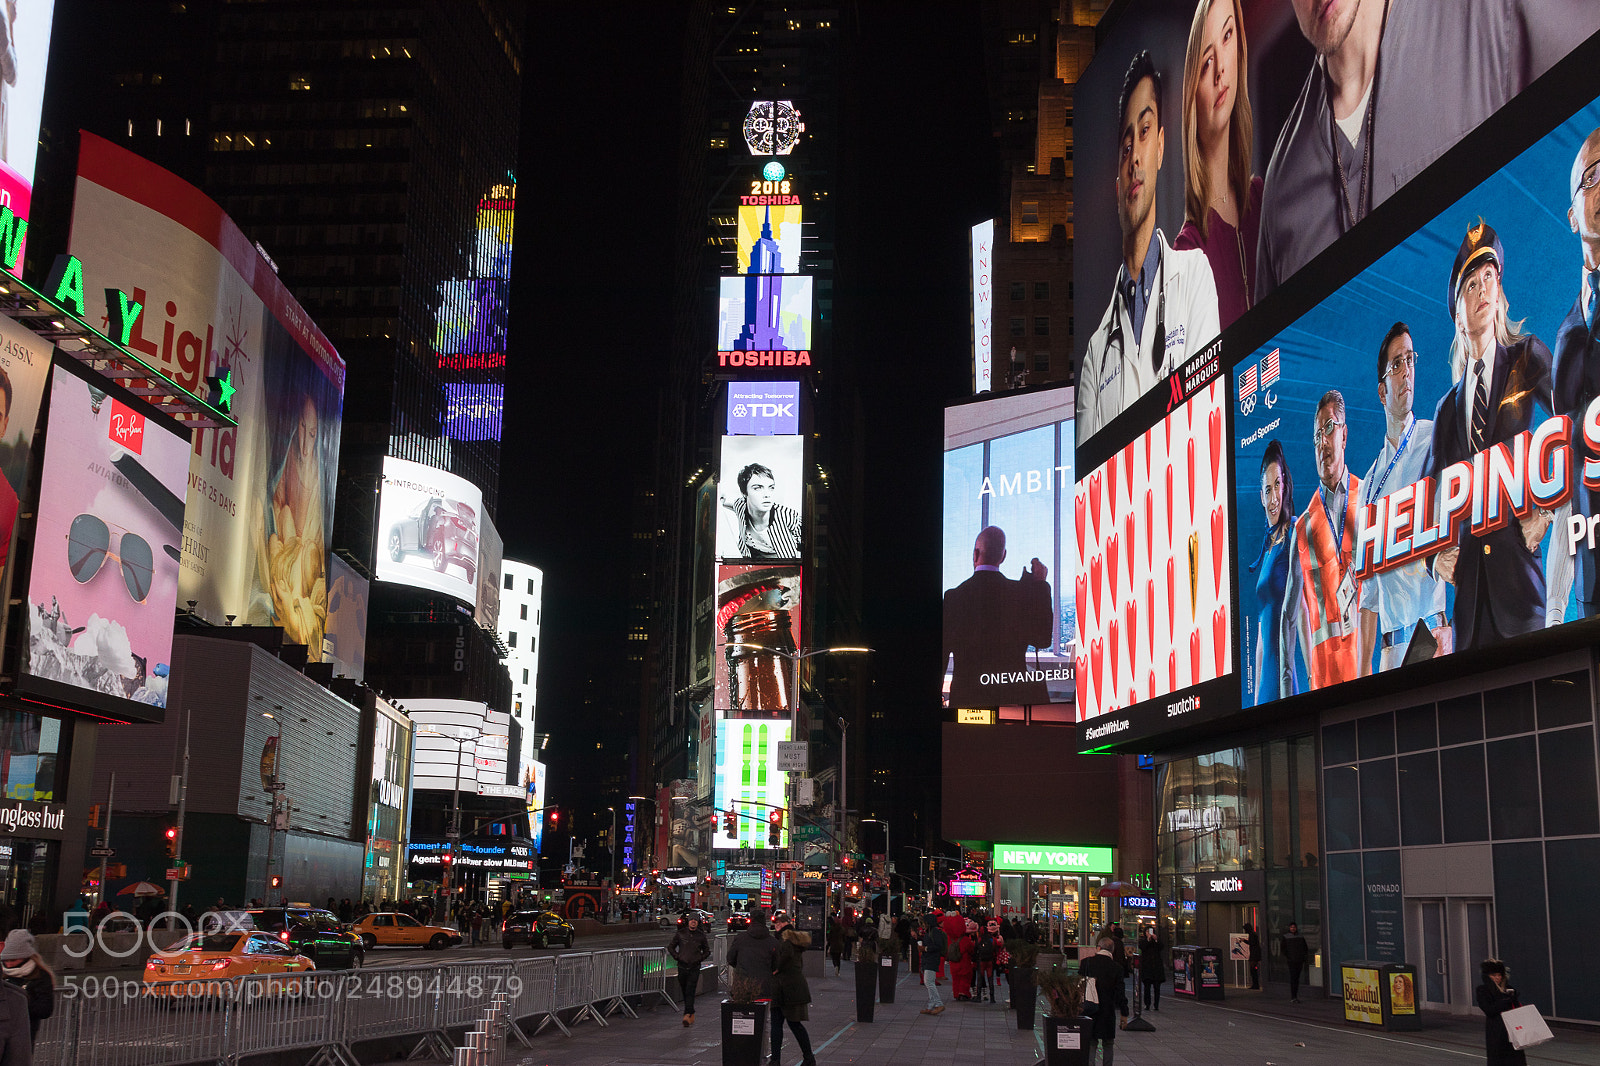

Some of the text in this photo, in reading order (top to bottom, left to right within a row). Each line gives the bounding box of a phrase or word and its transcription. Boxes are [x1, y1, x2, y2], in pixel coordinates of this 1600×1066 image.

[751, 181, 791, 195] 2018
[740, 195, 801, 206] TOSHIBA
[978, 241, 990, 303] KNOW
[4, 340, 34, 367] ASSN.
[718, 351, 811, 366] TOSHIBA
[980, 318, 990, 380] YOUR
[1185, 339, 1223, 378] MARRIOTT
[1185, 362, 1219, 393] MARQUIS
[747, 403, 794, 417] TDK
[1241, 417, 1281, 449] Proud Sponsor
[393, 479, 445, 498] INTRODUCING
[977, 465, 1072, 499] AMBIT
[208, 485, 217, 503] 25
[219, 493, 236, 517] DAYS
[1355, 414, 1574, 580] HELPING
[454, 624, 464, 672] 1500
[1167, 695, 1195, 717] swatch
[1085, 720, 1130, 740] #SwatchWithLove
[485, 786, 502, 794] THE
[43, 805, 65, 830] hut
[483, 859, 503, 867] slow
[1003, 851, 1089, 866] NEW YORK
[1210, 877, 1238, 892] swatch
[1367, 884, 1400, 893] VORNADO
[1345, 983, 1380, 1005] Beautiful
